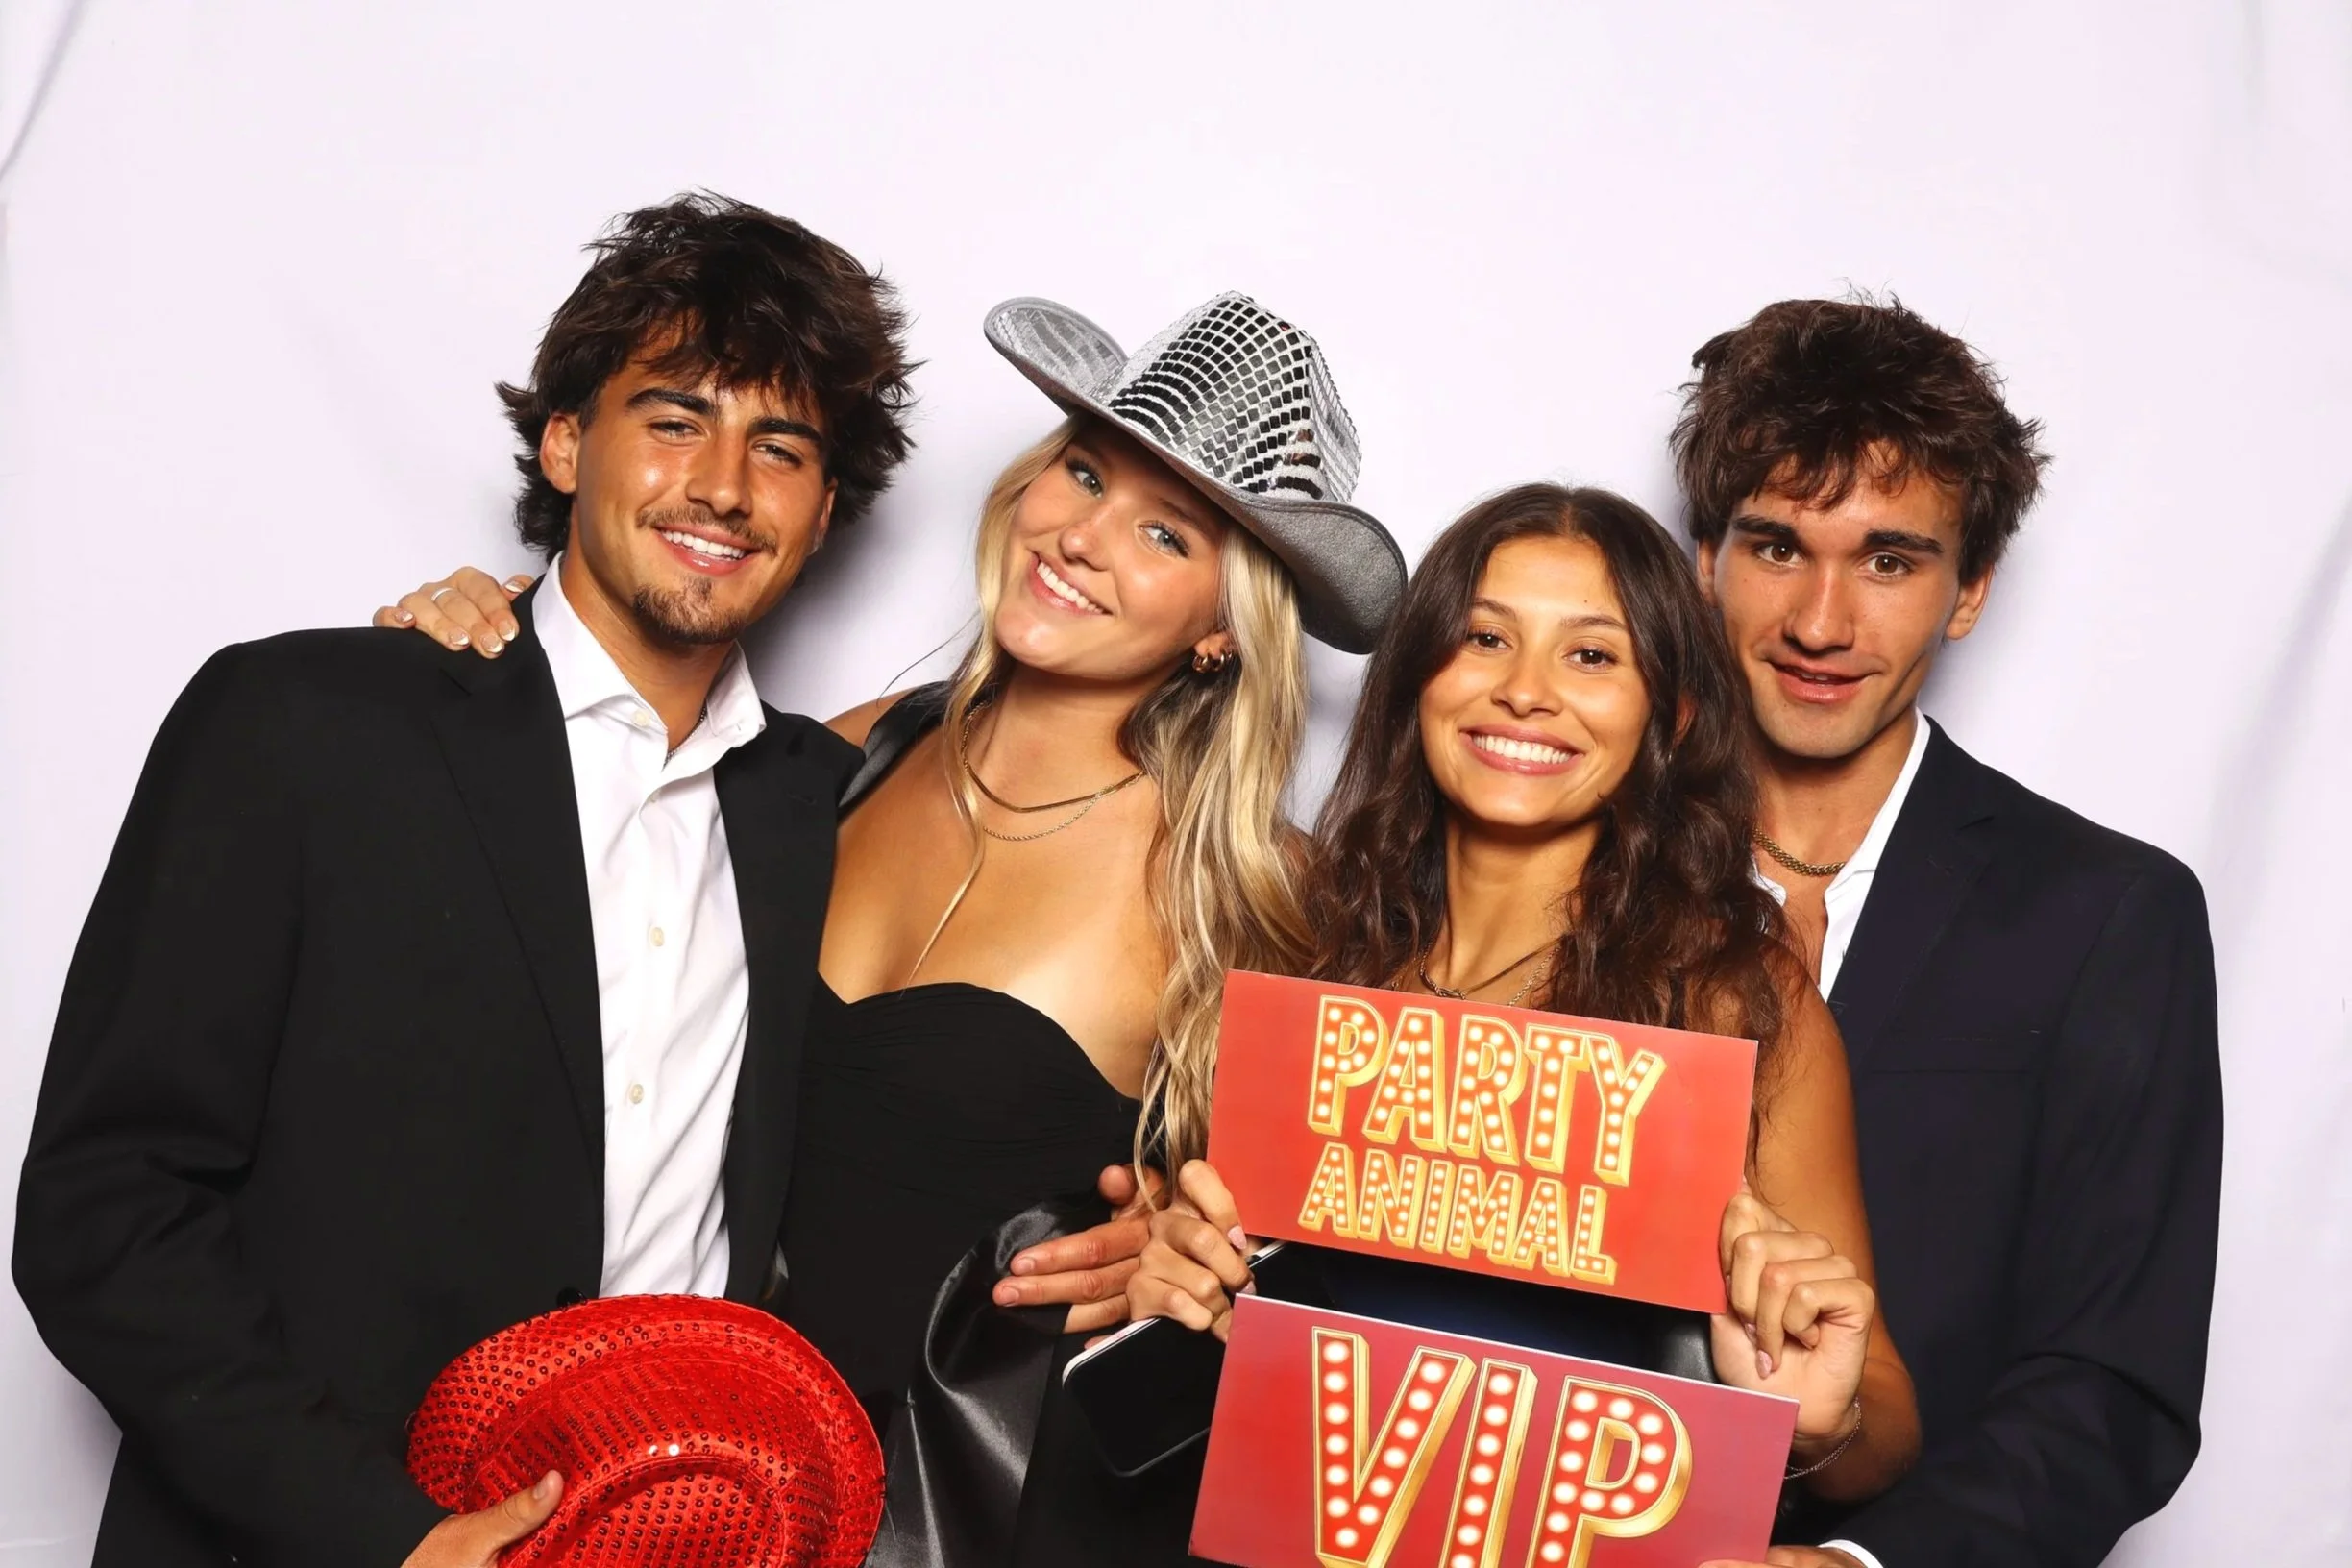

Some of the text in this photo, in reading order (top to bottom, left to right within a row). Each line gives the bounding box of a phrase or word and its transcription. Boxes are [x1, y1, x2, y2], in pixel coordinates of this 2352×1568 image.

[1308, 995, 1666, 1187] PARTY
[1298, 1142, 1618, 1285] ANIMAL
[1312, 1327, 1692, 1568] VIP
